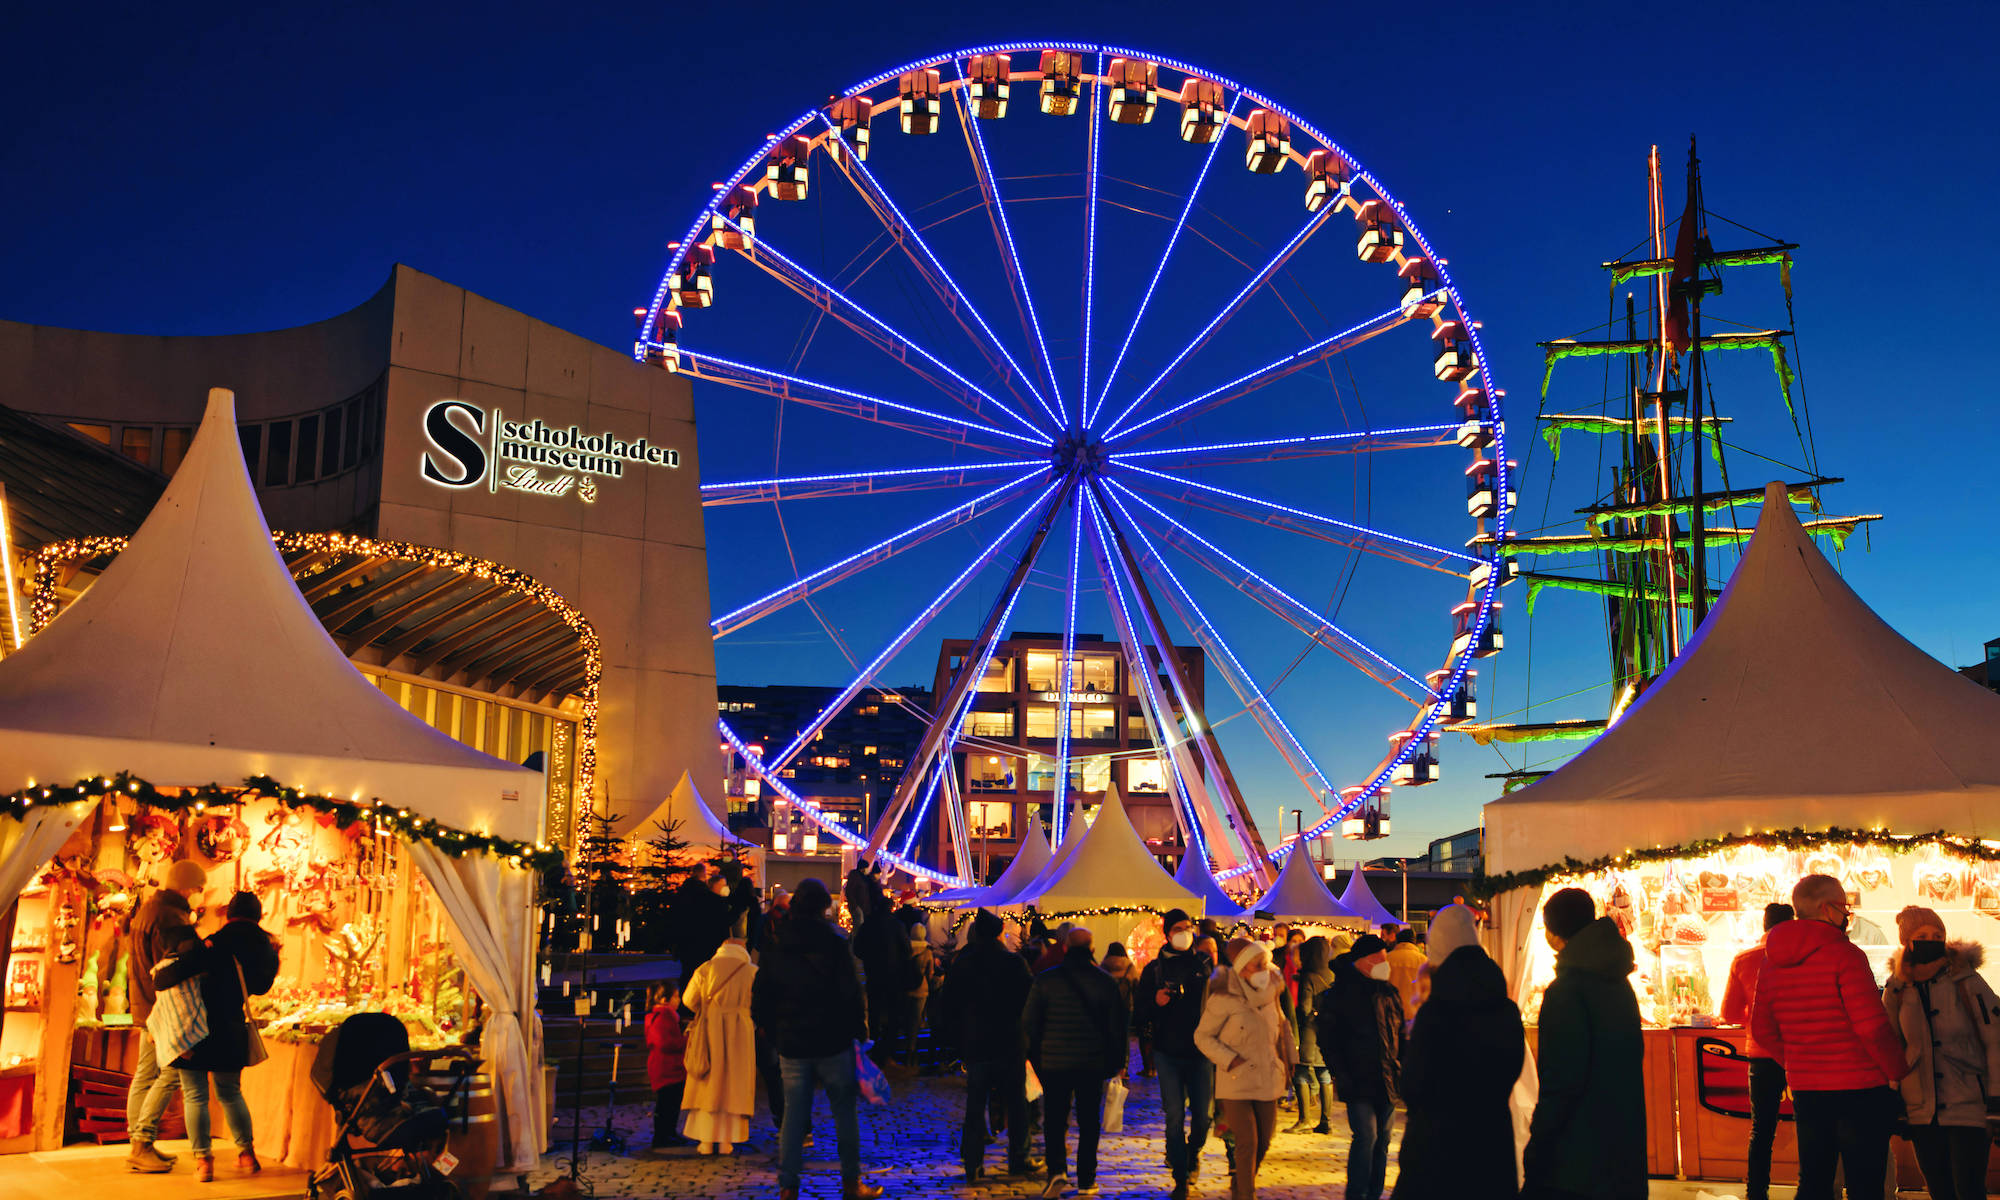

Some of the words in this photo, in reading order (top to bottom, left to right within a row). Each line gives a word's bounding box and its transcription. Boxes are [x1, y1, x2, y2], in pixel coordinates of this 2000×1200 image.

[424, 401, 486, 487] S
[502, 441, 622, 477] museum
[503, 420, 679, 467] schokoladen
[501, 465, 573, 496] Lindt
